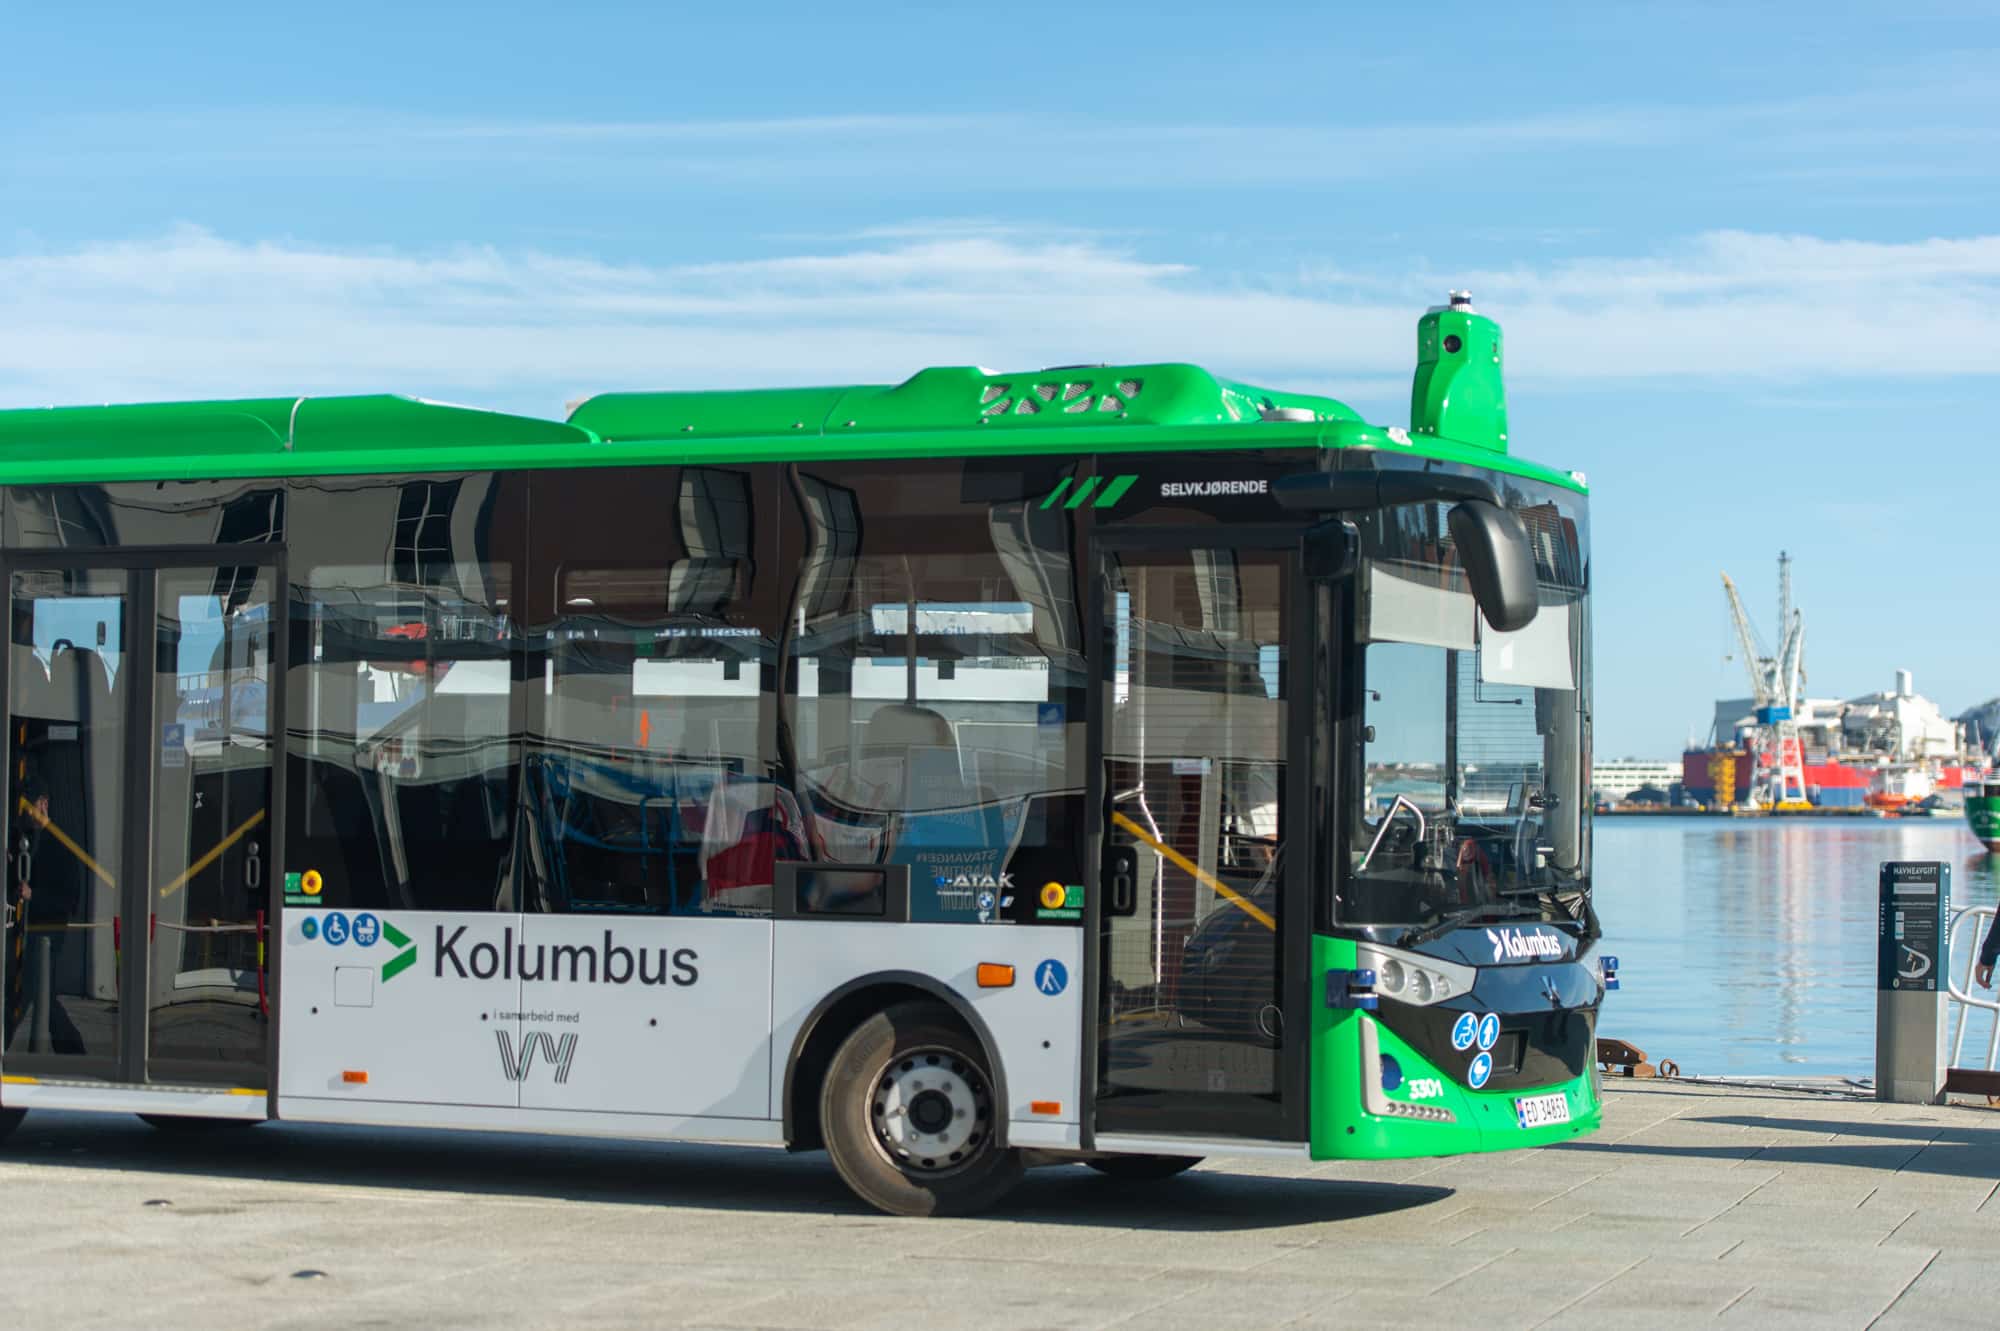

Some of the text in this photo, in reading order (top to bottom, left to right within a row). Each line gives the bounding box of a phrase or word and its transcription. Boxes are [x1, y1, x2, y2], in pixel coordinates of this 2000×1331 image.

[1161, 480, 1268, 497] SELVKJØRENDE
[1500, 927, 1562, 958] Kolumbus
[435, 924, 699, 986] Kolumbus
[493, 1010, 580, 1024] i samarbeid med
[1408, 1078, 1444, 1099] 3301
[1525, 1101, 1539, 1122] ED
